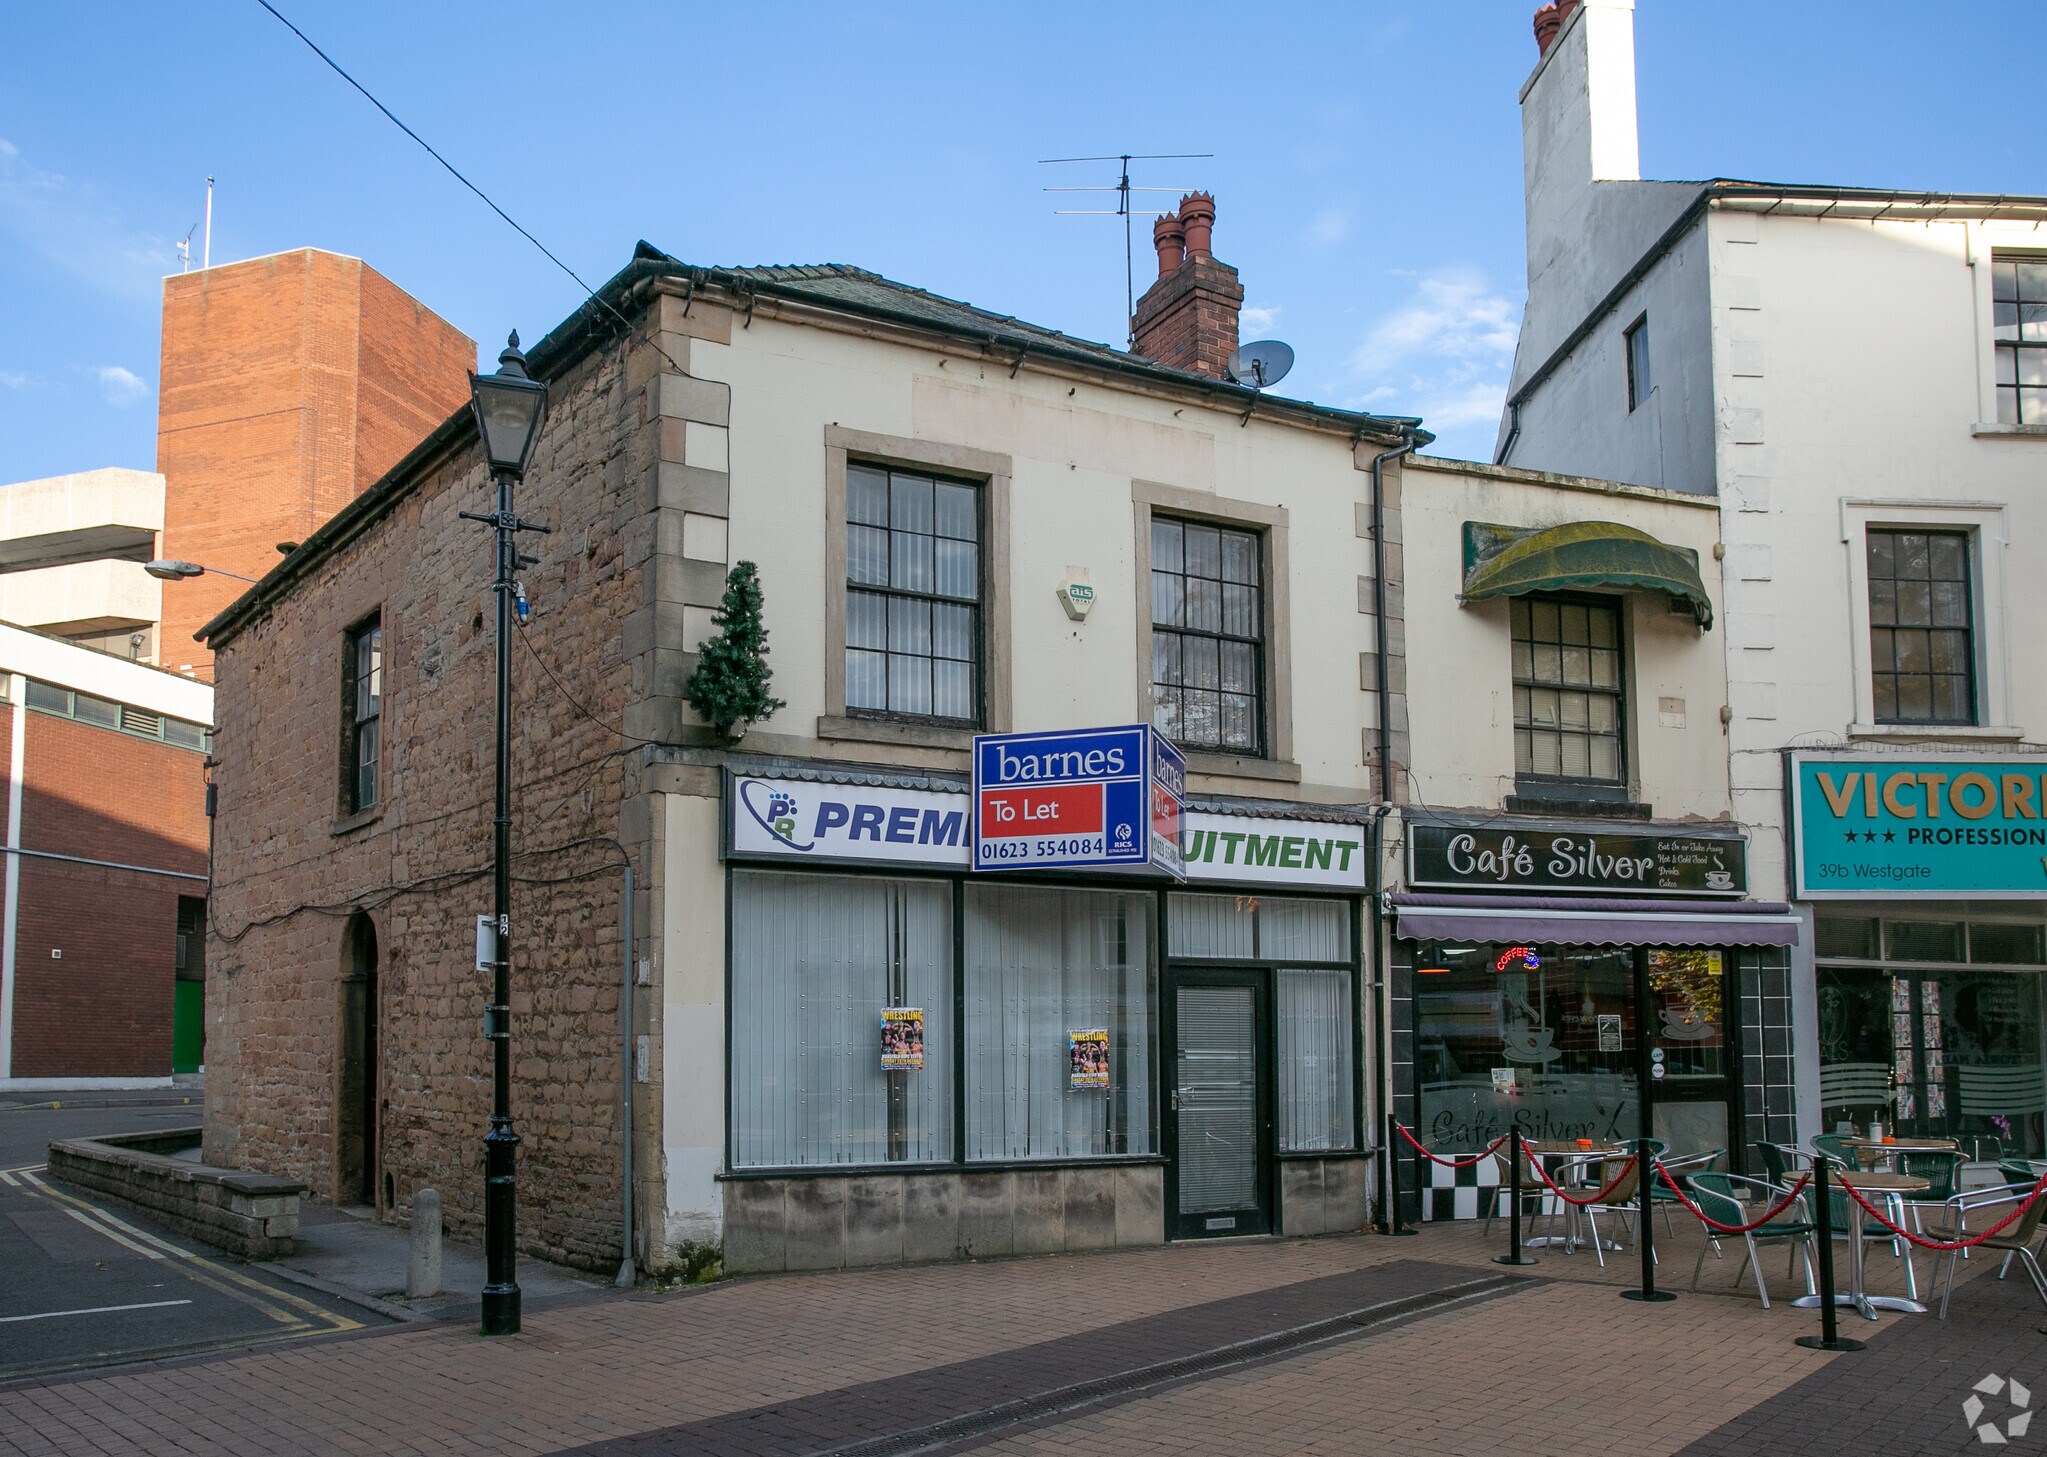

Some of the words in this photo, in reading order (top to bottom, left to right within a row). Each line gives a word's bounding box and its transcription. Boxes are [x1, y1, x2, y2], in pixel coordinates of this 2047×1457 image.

[997, 745, 1125, 781] barnes
[1156, 741, 1183, 796] barnes
[990, 800, 1016, 822] To
[1024, 799, 1059, 821] Let
[1908, 828, 2046, 845] PROFESSION
[982, 842, 1028, 860] 01623
[1036, 838, 1103, 857] 554084
[1447, 833, 1535, 881] Café
[1548, 837, 1654, 881] Silver
[1658, 865, 1680, 876] Drinks
[1819, 863, 1849, 878] 39b
[1853, 863, 1931, 881] Westgate
[1496, 947, 1529, 971] COFFEE
[882, 1010, 923, 1020] WRESTLING
[1071, 1031, 1108, 1041] WRESTLING
[1432, 1110, 1499, 1150] Café
[1514, 1108, 1595, 1139] Silver
